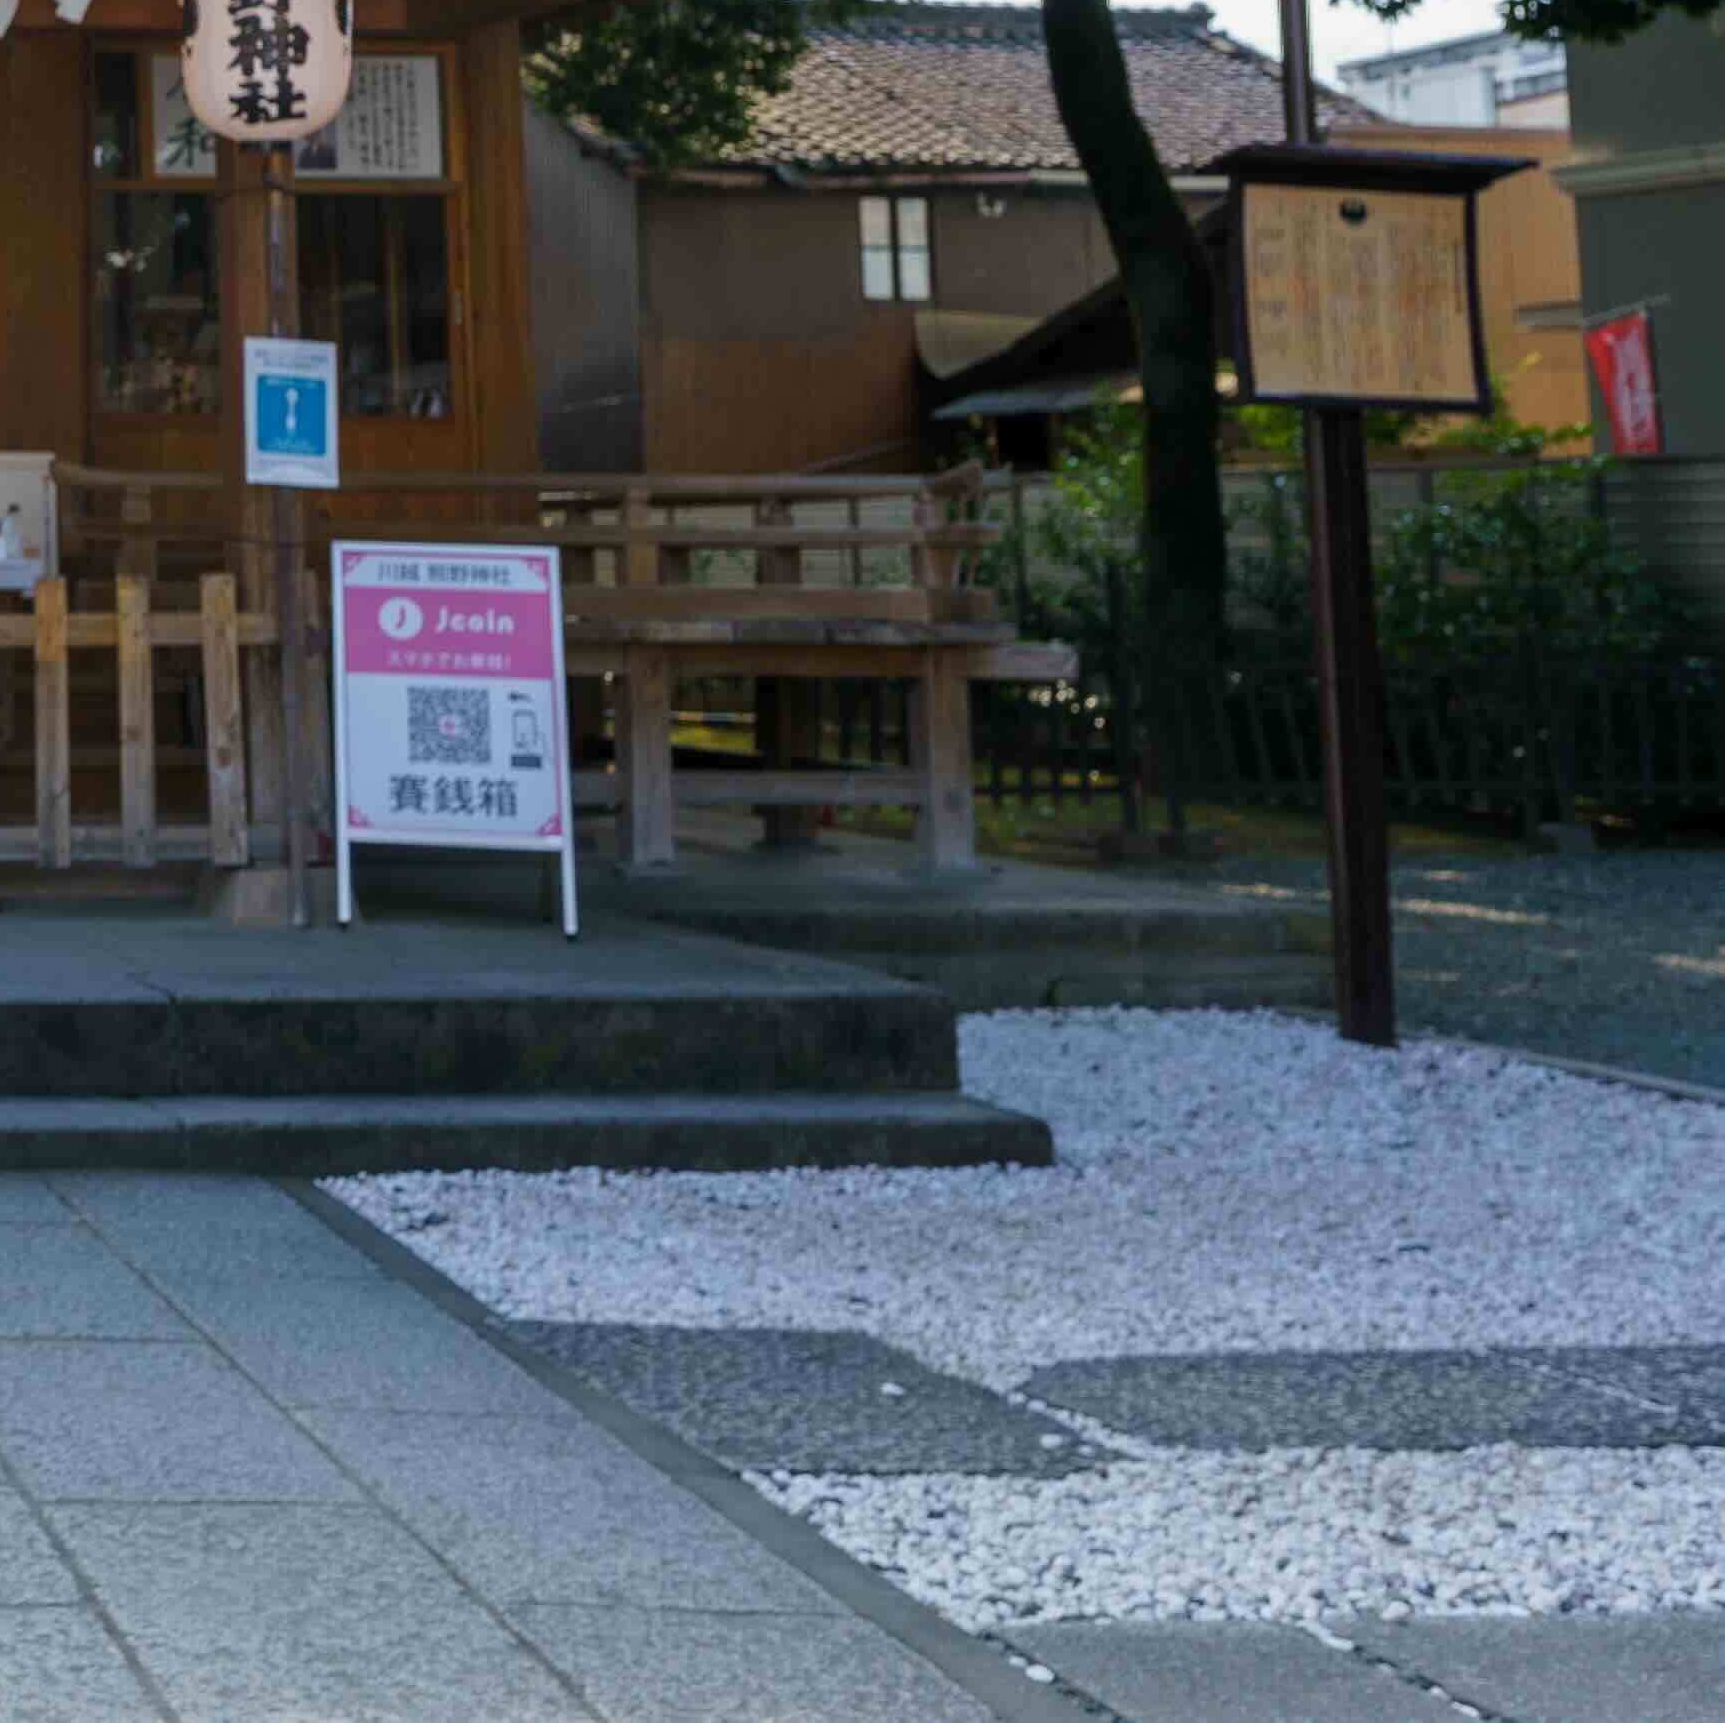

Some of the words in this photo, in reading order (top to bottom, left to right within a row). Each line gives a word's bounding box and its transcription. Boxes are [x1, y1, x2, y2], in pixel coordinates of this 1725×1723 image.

[434, 605, 515, 636] Jcoin
[389, 774, 518, 817] 賽銭箱
